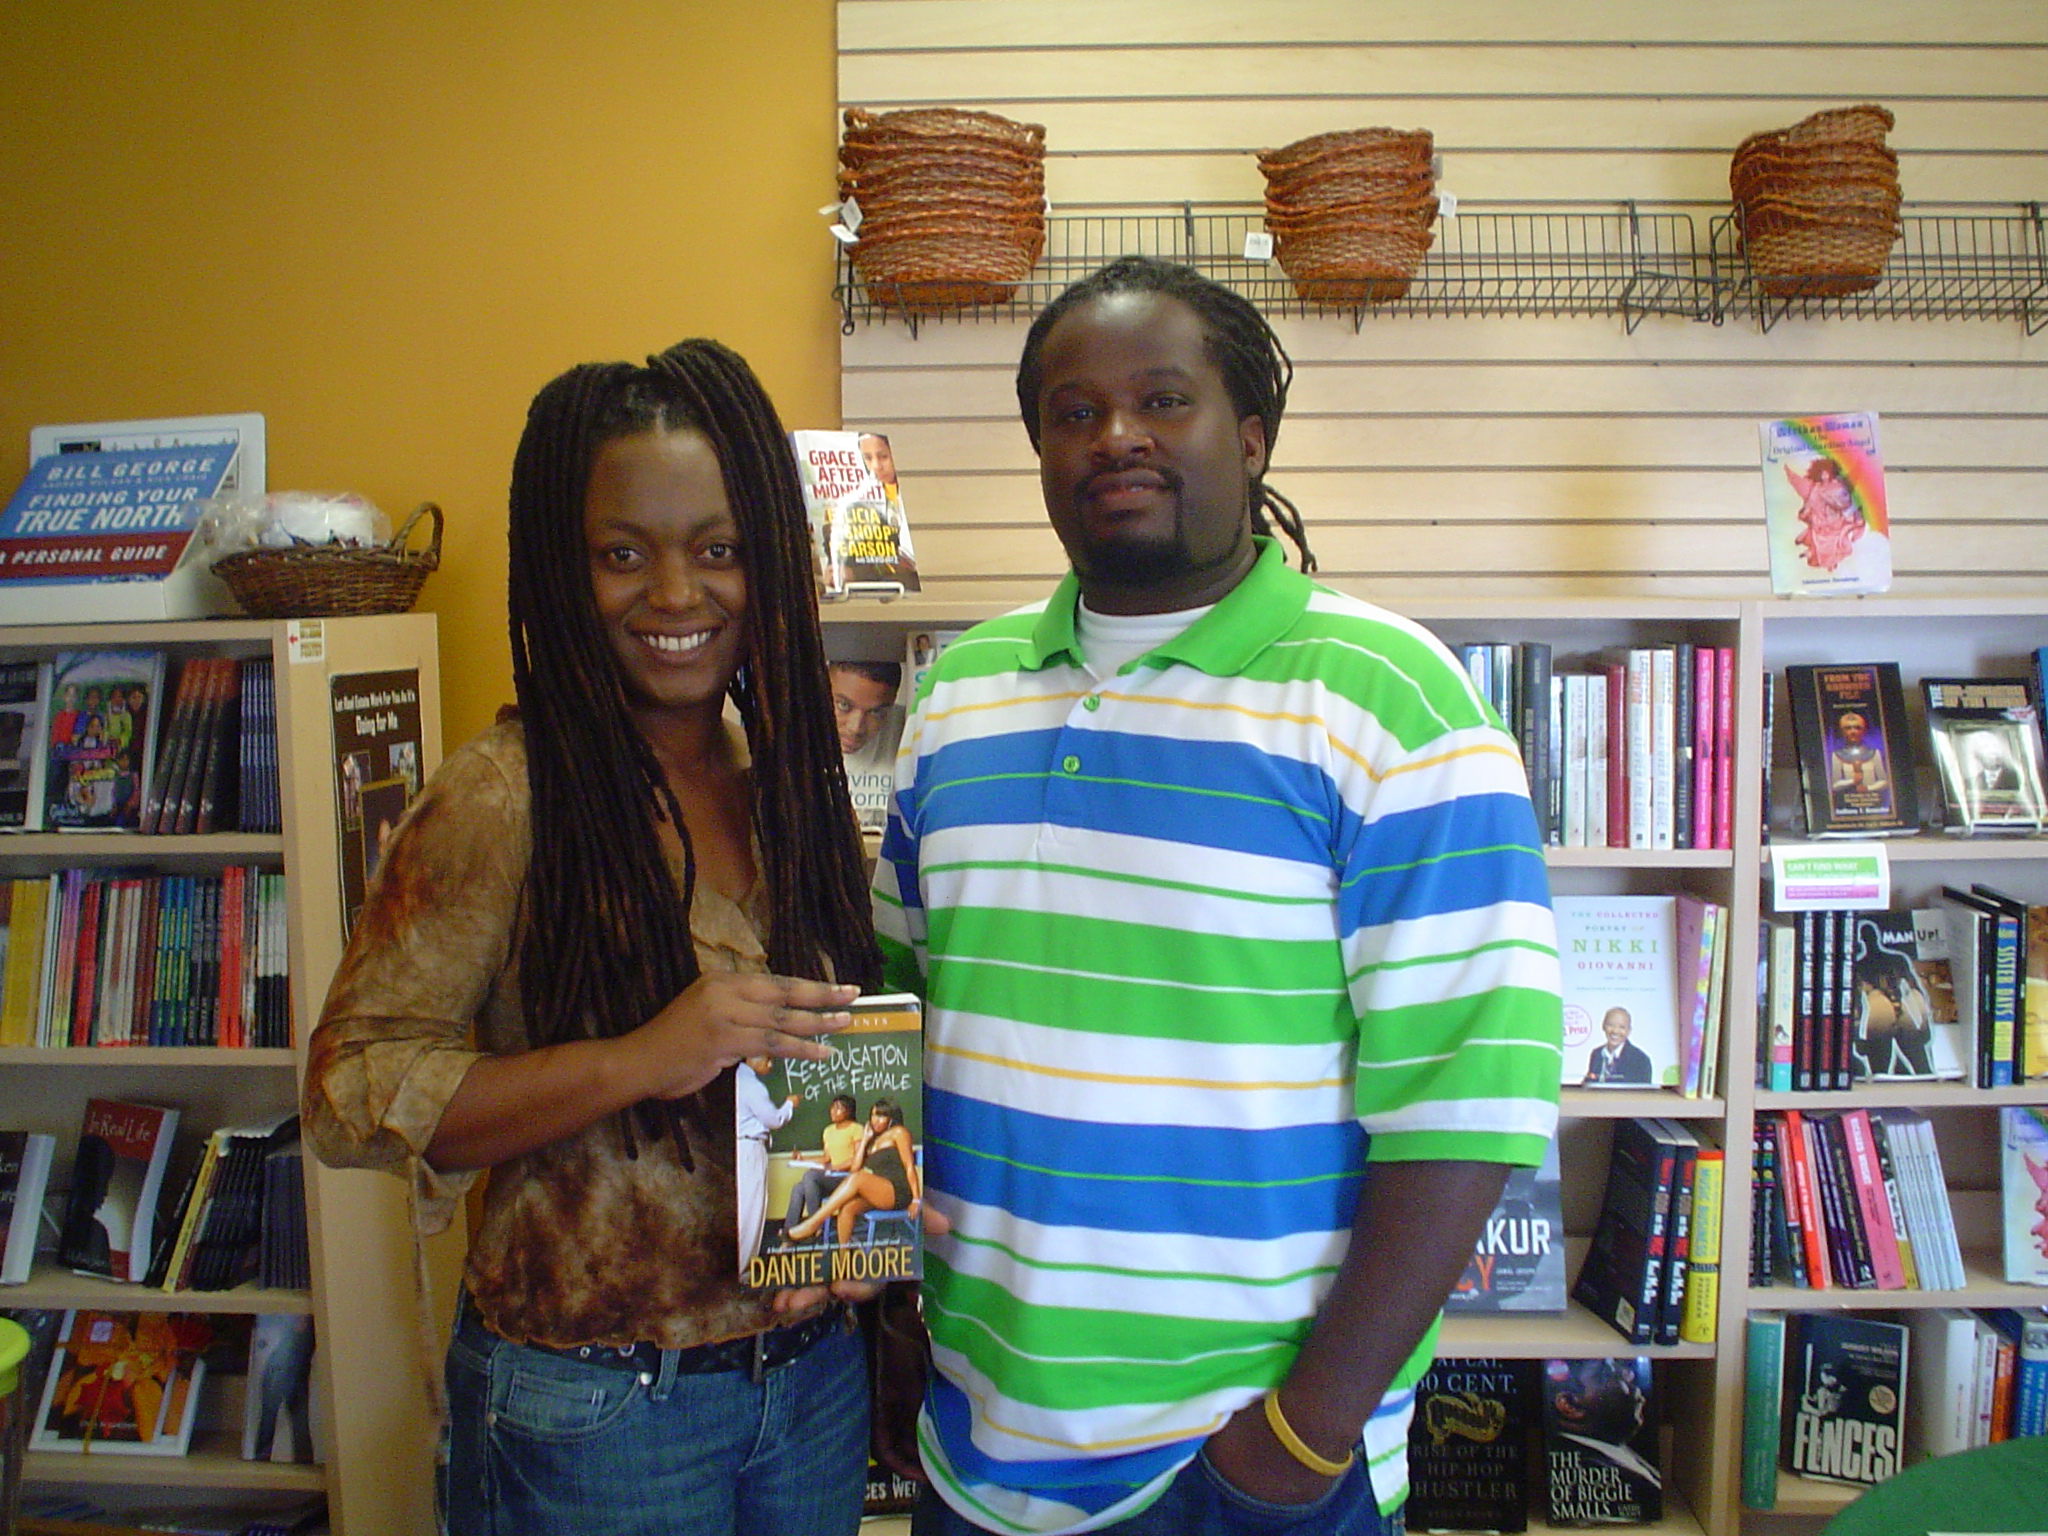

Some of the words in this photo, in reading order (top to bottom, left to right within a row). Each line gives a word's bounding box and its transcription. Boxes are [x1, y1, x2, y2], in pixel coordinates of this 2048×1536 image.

[809, 450, 857, 467] GRACE
[47, 465, 103, 481] BILL
[112, 458, 216, 477] GEORGE
[818, 465, 864, 483] AFTER
[28, 491, 129, 509] FINDING
[136, 487, 198, 504] YOUR
[812, 482, 883, 500] MIDNHT
[15, 509, 89, 534] TRUE
[12, 547, 102, 565] PERSONAL
[111, 545, 169, 561] GUIDE
[838, 541, 896, 558] EARSON
[344, 695, 354, 710] Real
[370, 692, 382, 708] Work
[356, 715, 376, 736] Doing
[1787, 863, 1812, 872] CAN'T
[1813, 862, 1832, 871] FIND
[1833, 862, 1858, 870] WHAT
[1572, 939, 1659, 954] NIKKI
[1882, 931, 1914, 944] MAN
[1577, 962, 1654, 970] GIOVANNI
[1997, 946, 2016, 984] SISTER
[1995, 988, 2015, 1016] DAYS
[853, 1017, 888, 1028] ENTS
[804, 1083, 821, 1102] OF
[823, 1076, 846, 1094] THE
[850, 1068, 912, 1094] FEMALE
[750, 1251, 824, 1289] DANTE
[831, 1246, 915, 1282] MOORE
[1457, 1445, 1476, 1457] OF
[1487, 1446, 1517, 1458] THE
[1793, 1412, 1896, 1483] FENCES
[1549, 1451, 1581, 1469] THE
[1427, 1463, 1458, 1476] HIP
[1467, 1463, 1504, 1476] HOP
[1550, 1467, 1621, 1485] MURDER
[1414, 1482, 1517, 1498] HUSTLER
[1550, 1485, 1573, 1503] OF
[1577, 1483, 1633, 1503] BIGGIE
[1552, 1503, 1610, 1520] SMALLS
